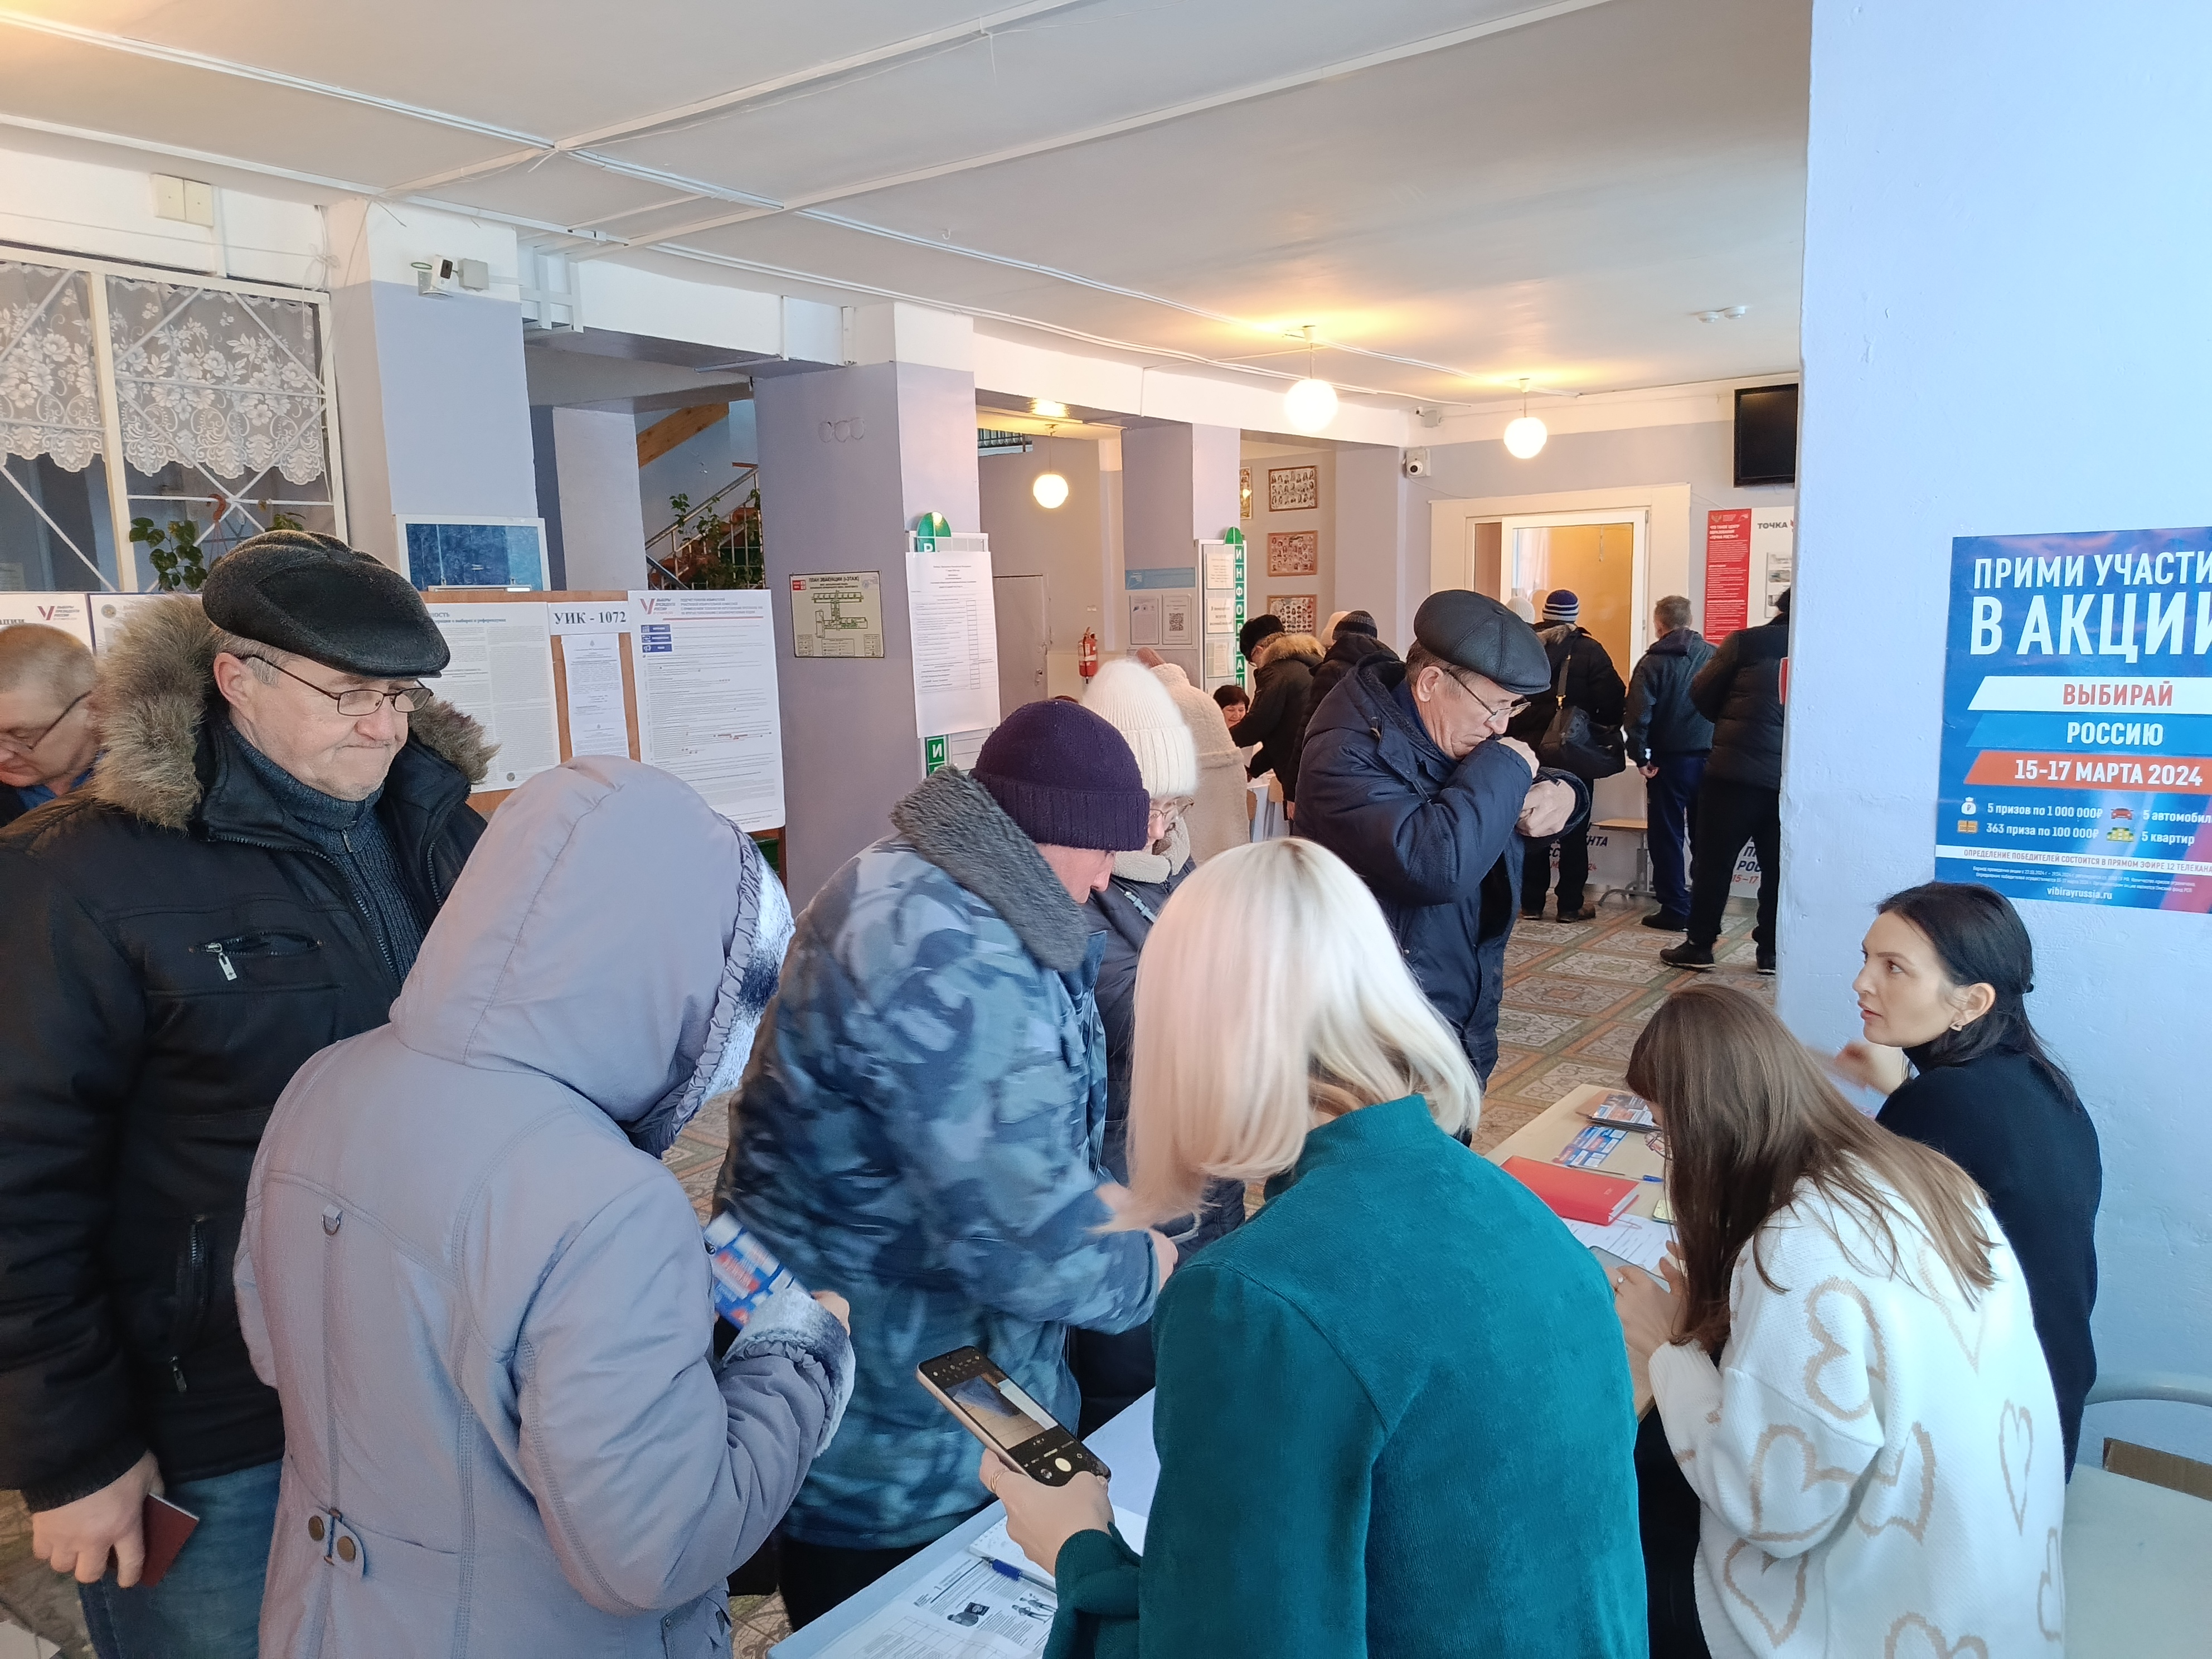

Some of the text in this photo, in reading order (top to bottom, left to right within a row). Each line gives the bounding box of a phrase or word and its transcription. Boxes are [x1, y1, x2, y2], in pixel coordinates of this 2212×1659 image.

[1973, 551, 2212, 589] ПРИМИ УЧАСТИ
[553, 612, 586, 624] УИК
[599, 611, 627, 623] 1072
[1970, 596, 2002, 655] В
[2063, 681, 2172, 706] ВЫБИРАЙ
[2067, 721, 2164, 745] РОССИЮ
[2014, 759, 2203, 787] 15-17 МАРТА 2024
[1987, 803, 1993, 813] 5
[1995, 806, 2031, 814] призов
[2143, 810, 2150, 820] 5
[1986, 823, 2004, 833] 363
[2006, 826, 2035, 835] приза
[2038, 827, 2050, 836] по
[2053, 827, 2071, 837] 100
[2141, 831, 2195, 846] 5 квартир
[1964, 849, 2010, 859] ОПРЕДЕЛЕНИЕ
[2012, 852, 2060, 862] ПОБЕДИТЕЛЕЙ
[2061, 856, 2099, 865] СОСТОИТСЯ
[2108, 859, 2138, 867] ПРЯМОМ
[2047, 886, 2113, 899] vibirayrussia.ru
